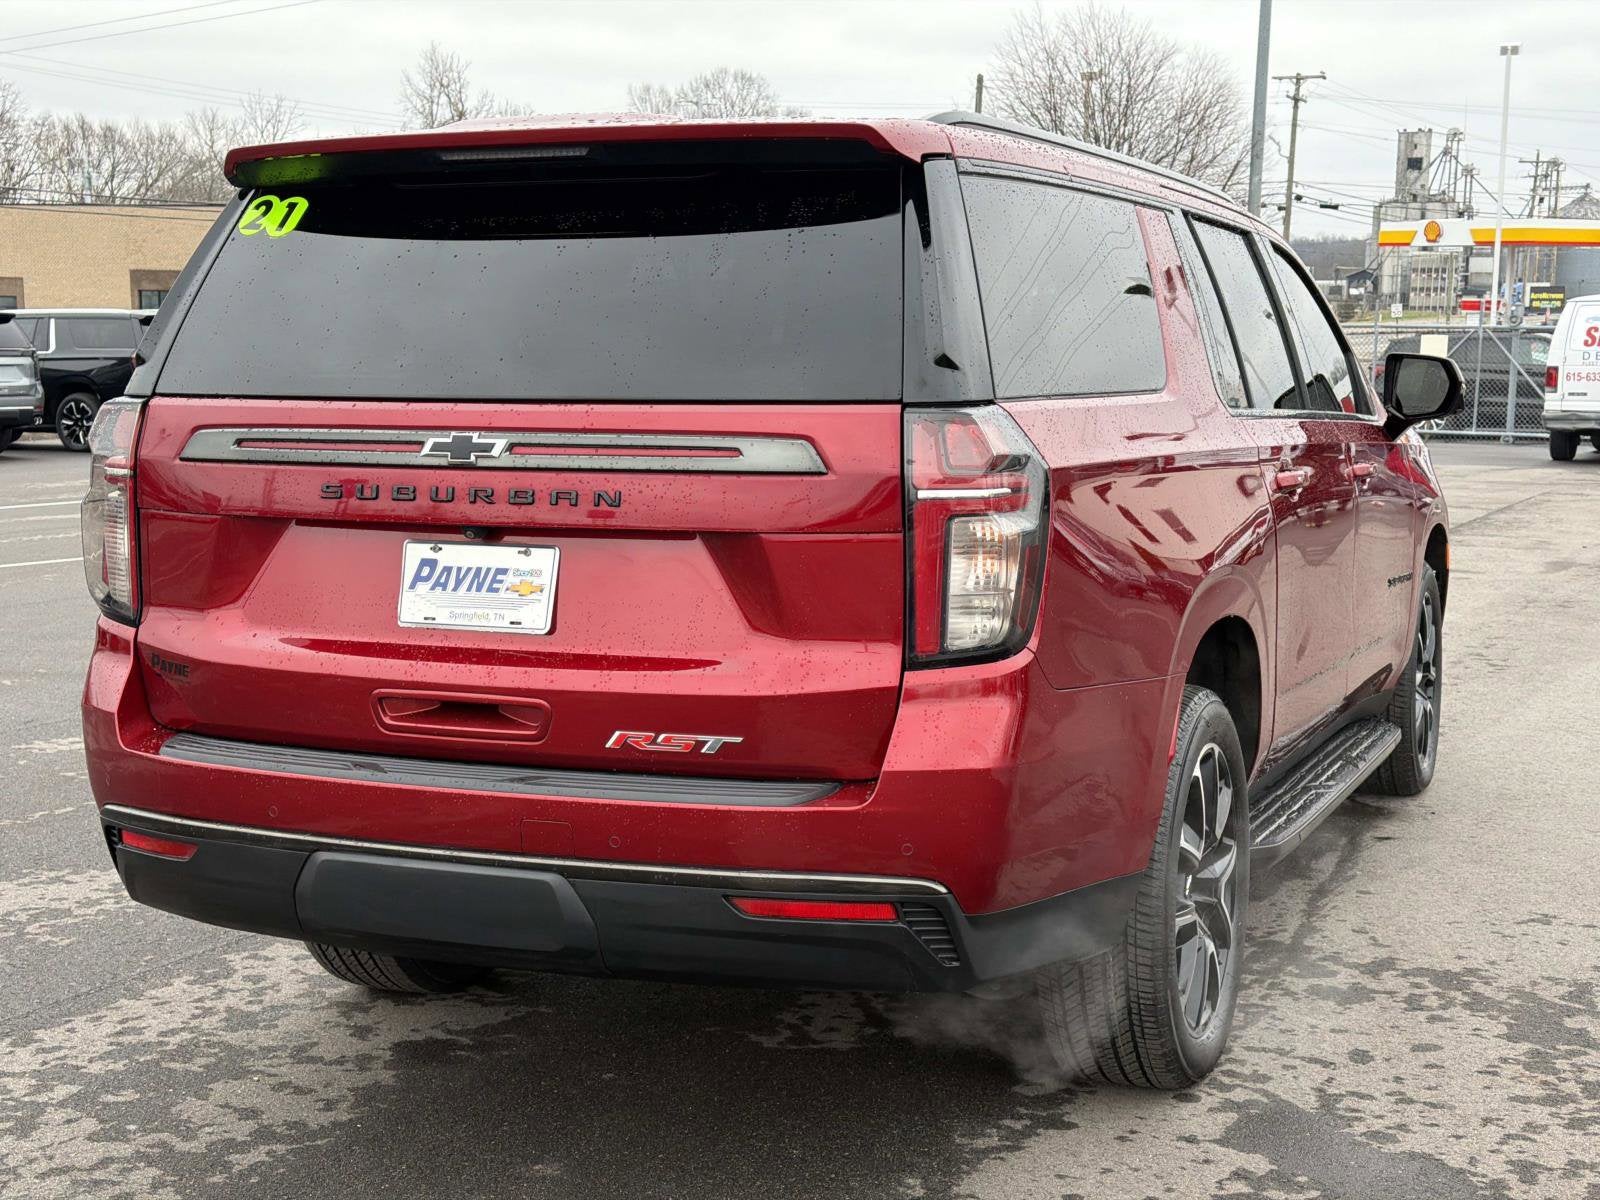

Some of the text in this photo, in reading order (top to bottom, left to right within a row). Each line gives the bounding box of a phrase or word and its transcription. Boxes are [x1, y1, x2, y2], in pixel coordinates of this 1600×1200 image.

[240, 195, 309, 237] 21
[320, 483, 623, 508] SUBURBAN
[405, 557, 511, 595] PAYNE
[150, 653, 190, 677] PAYNE
[605, 730, 744, 754] RST
